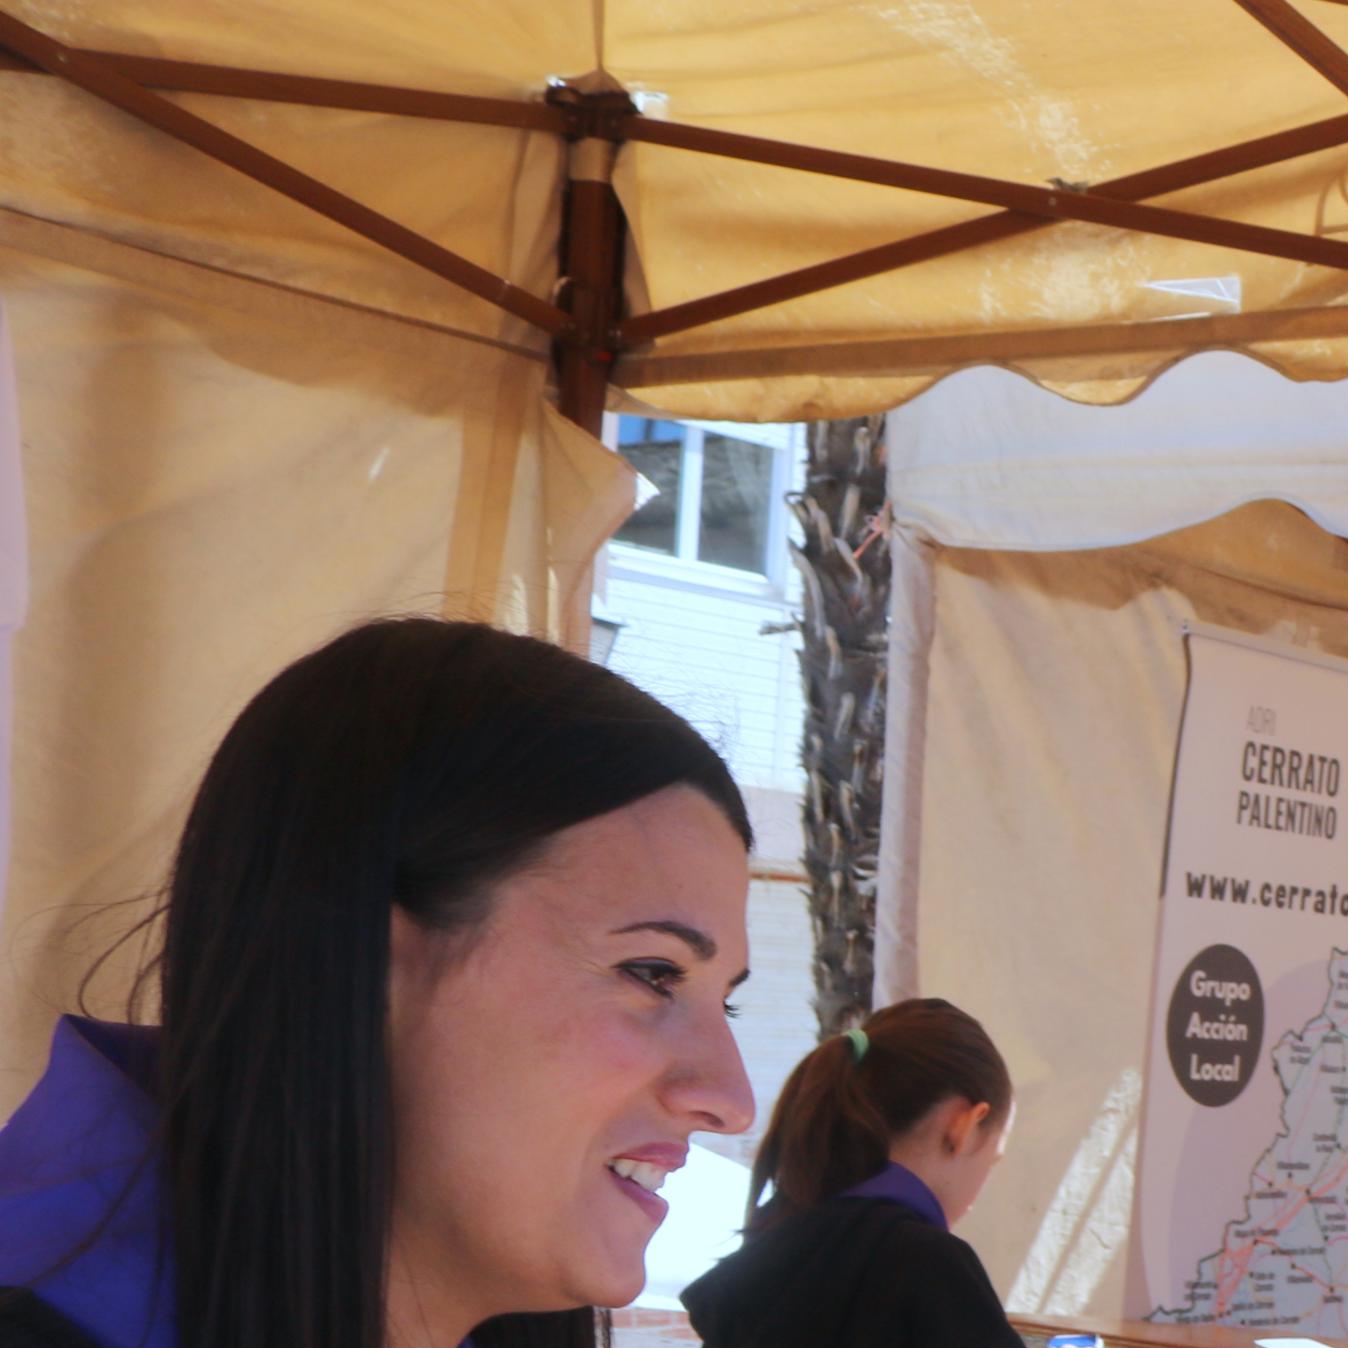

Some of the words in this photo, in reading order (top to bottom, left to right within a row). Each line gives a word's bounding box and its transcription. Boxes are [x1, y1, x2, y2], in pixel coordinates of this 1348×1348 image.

[1242, 740, 1340, 798] CERRATO
[1236, 790, 1338, 841] PALENTINO
[1189, 969, 1251, 1006] Grupo
[1185, 1012, 1249, 1042] Acción
[1189, 1055, 1241, 1082] Local
